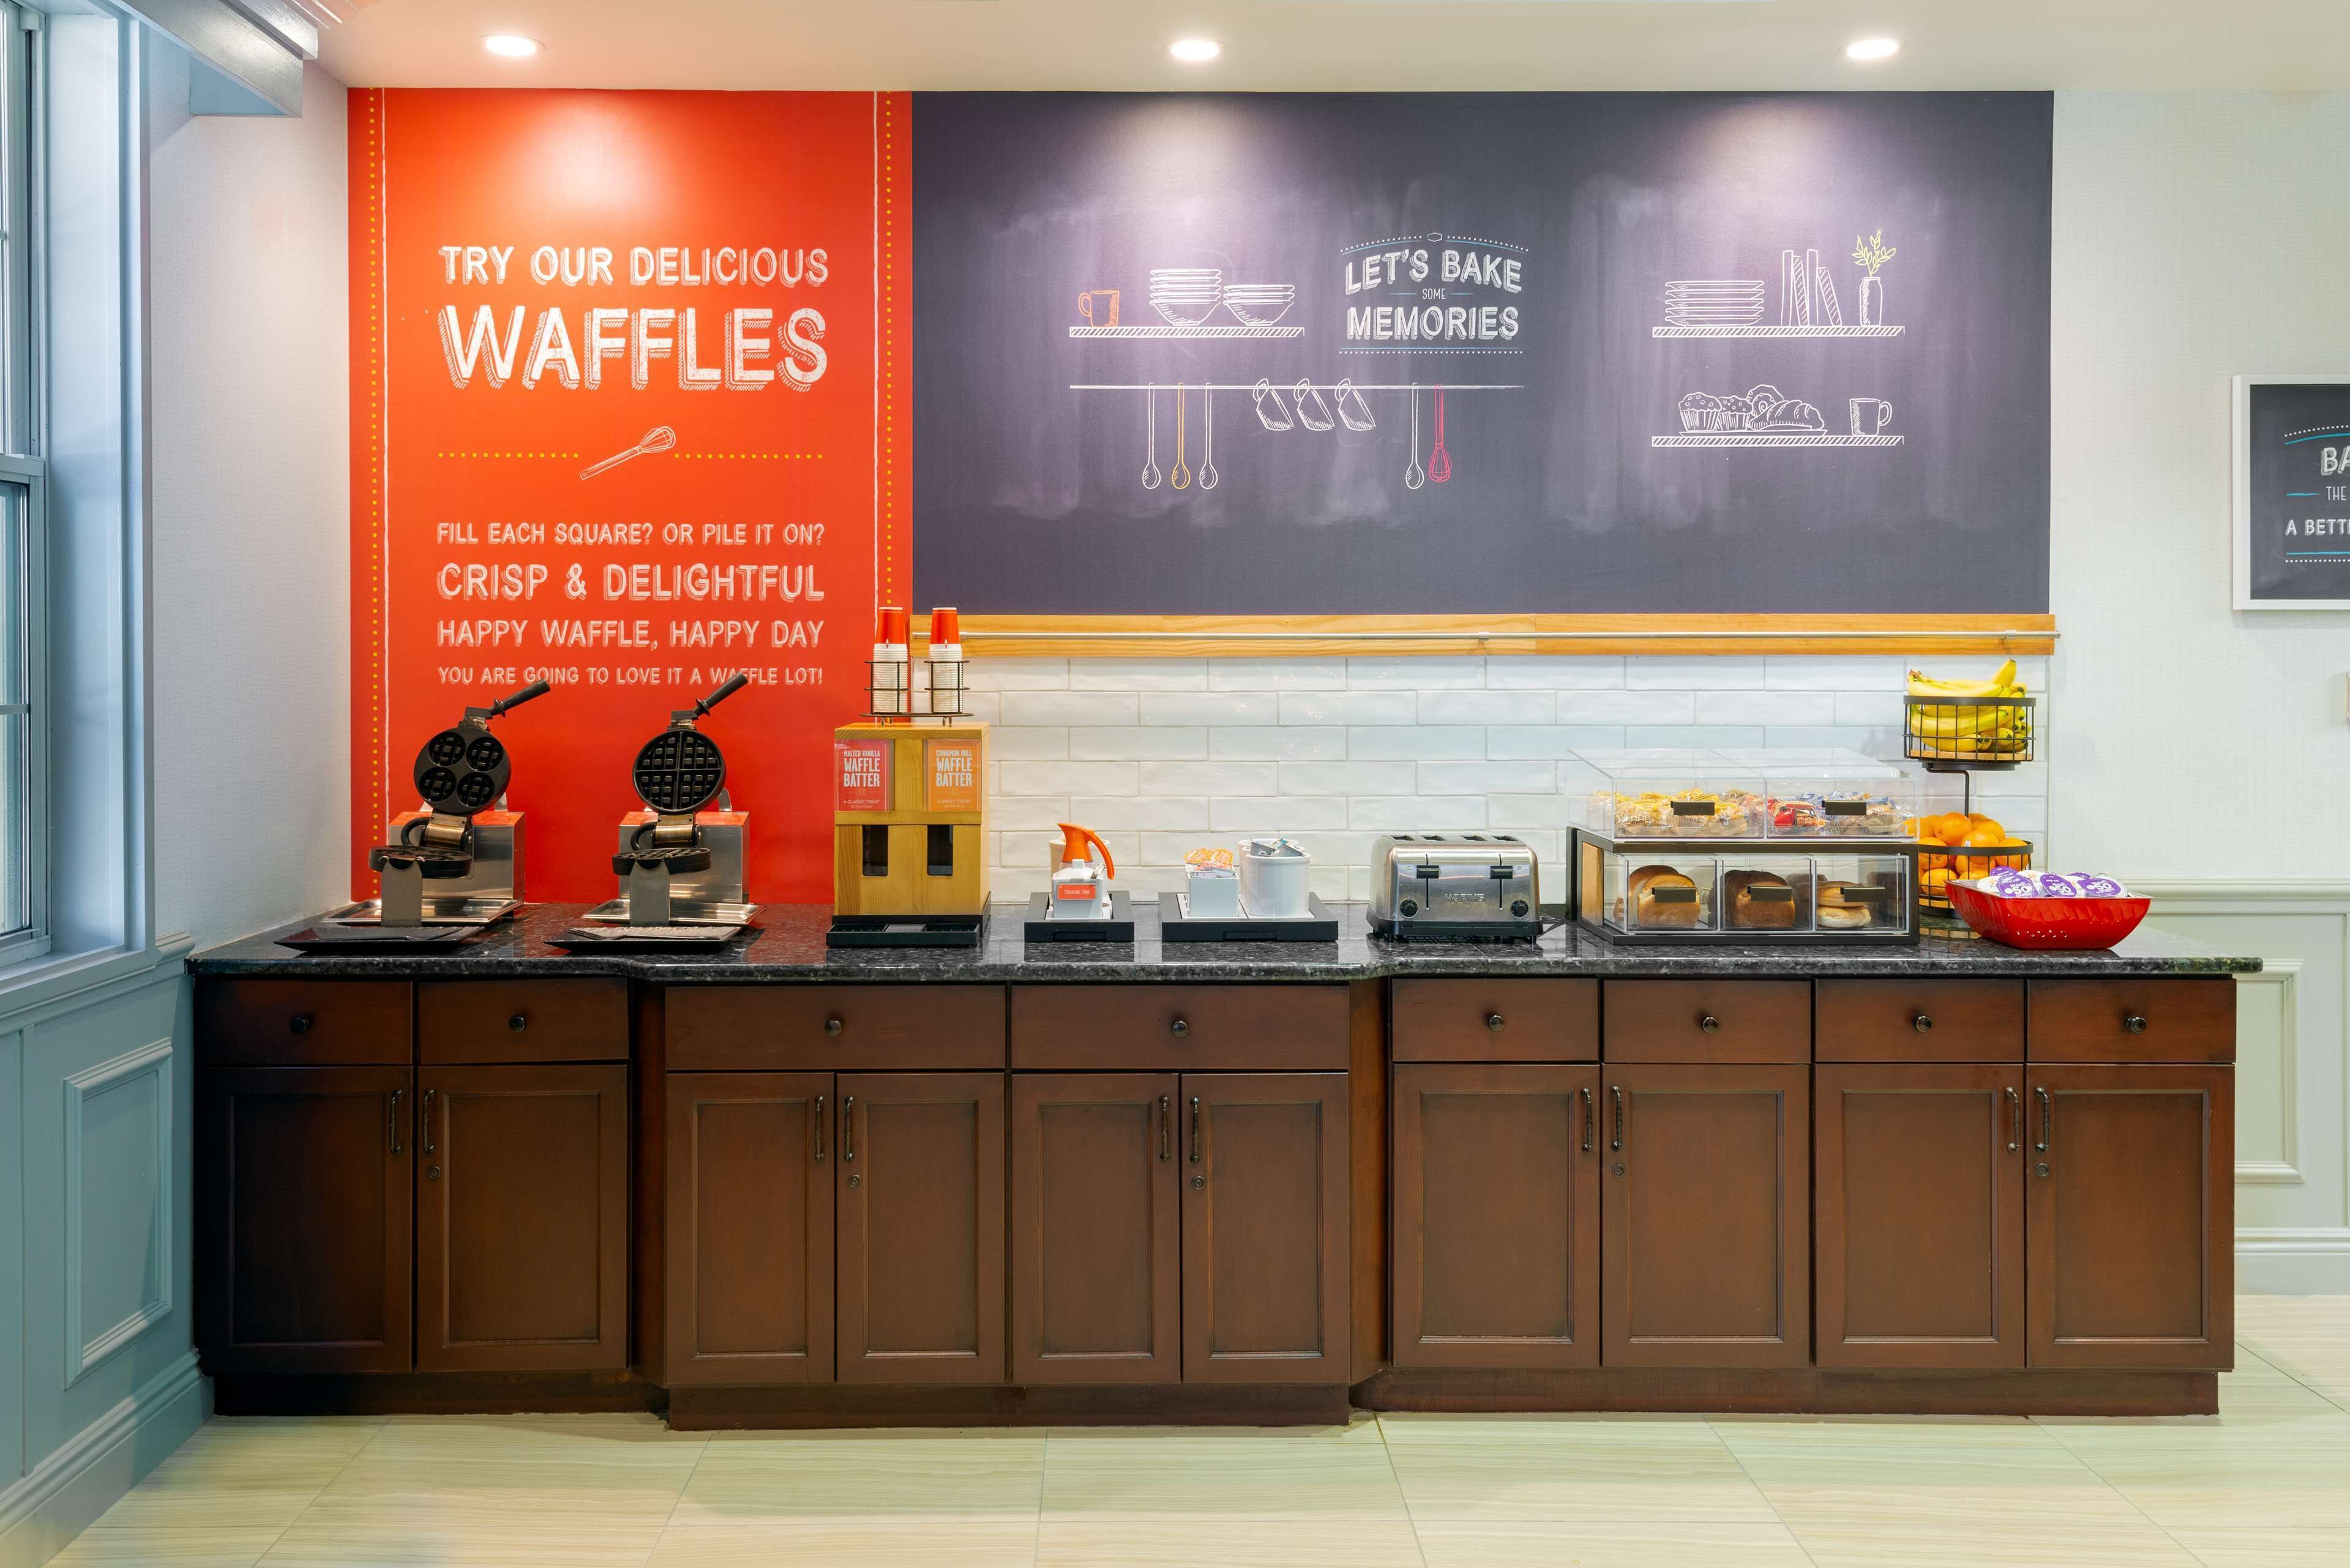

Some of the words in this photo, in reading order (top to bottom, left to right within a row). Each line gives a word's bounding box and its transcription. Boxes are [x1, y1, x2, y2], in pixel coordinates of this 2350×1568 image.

[438, 245, 514, 284] TRY
[531, 245, 613, 286] OUR
[631, 246, 828, 287] DELICIOUS
[1346, 249, 1429, 295] LET'S
[1442, 250, 1522, 294] BAKE
[1422, 288, 1445, 299] SOME
[1347, 306, 1519, 340] MEMORIES
[438, 305, 828, 392] WAFFLES
[2326, 486, 2347, 501] THE
[437, 523, 478, 544] FILL
[487, 523, 545, 544] EACH
[554, 523, 654, 545] SQUARE?
[662, 523, 693, 545] OR
[703, 523, 747, 545] PILE
[755, 523, 774, 545] IT
[783, 523, 825, 545] ON?
[2285, 520, 2297, 536] A
[436, 563, 548, 602] CRISP
[565, 563, 588, 601] &
[603, 563, 825, 602] DELIGHTFUL
[437, 619, 528, 647] HAPPY
[541, 619, 659, 651] WAFFLE,
[669, 620, 760, 647] HAPPY
[771, 620, 824, 647] DAY
[438, 666, 473, 685] YOU
[481, 667, 515, 684] ARE
[523, 667, 579, 684] GOING
[587, 667, 609, 684] TO
[616, 667, 660, 684] LOVE
[667, 667, 683, 684] IT
[689, 667, 702, 684] A
[784, 667, 823, 685] LOT!
[844, 758, 880, 772] WAFFLE
[936, 758, 972, 772] WAFFLE
[844, 773, 880, 787] BATTER
[936, 773, 972, 787] BATTER
